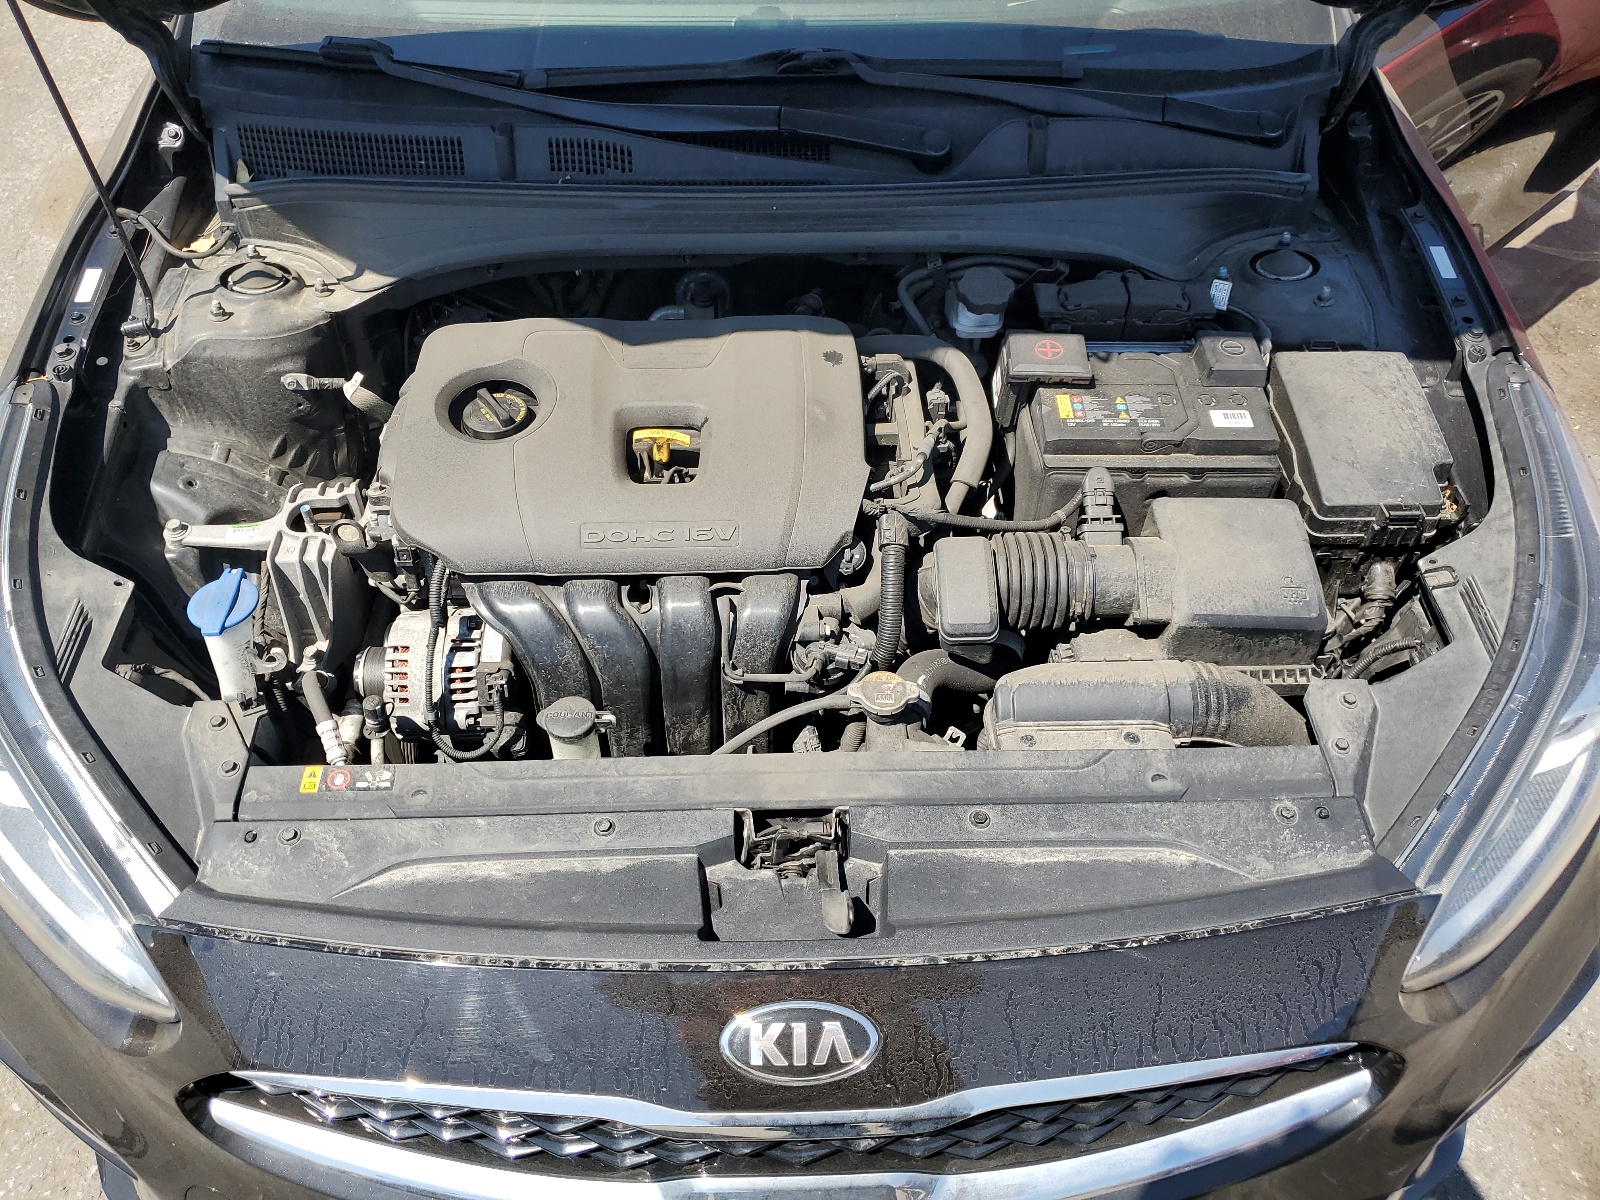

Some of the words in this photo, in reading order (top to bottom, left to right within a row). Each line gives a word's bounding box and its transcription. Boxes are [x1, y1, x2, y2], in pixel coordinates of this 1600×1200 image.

[583, 528, 675, 544] DOHC
[684, 526, 738, 542] 16V
[546, 710, 594, 719] COOLANT
[749, 1020, 854, 1066] KIA
